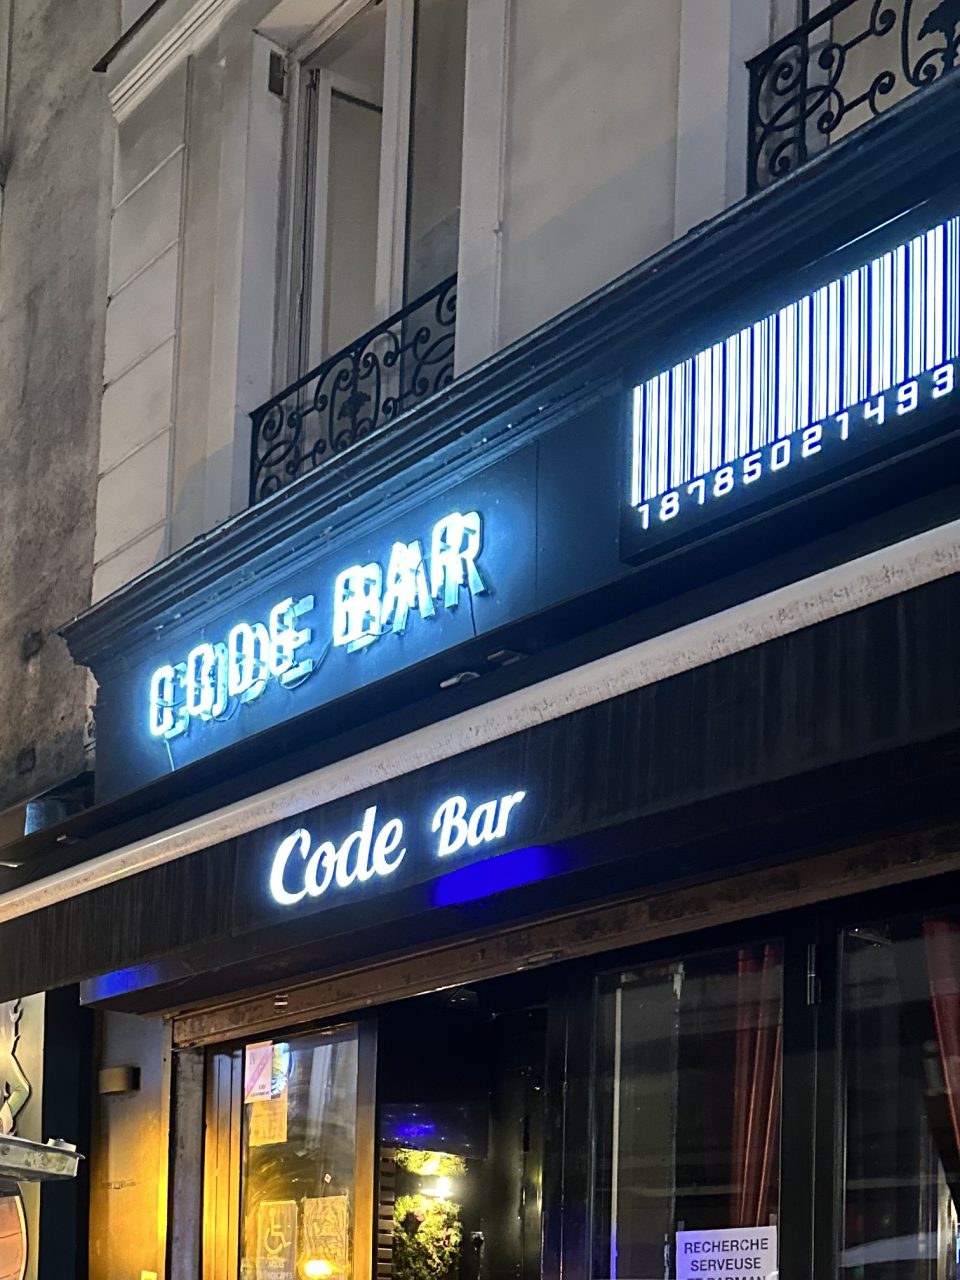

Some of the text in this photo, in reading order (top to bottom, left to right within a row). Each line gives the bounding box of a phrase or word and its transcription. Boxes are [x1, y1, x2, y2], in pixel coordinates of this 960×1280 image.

[149, 510, 486, 740] CODE BAR
[268, 789, 527, 906] Code Bar
[684, 1238, 769, 1254] RECHERCHE
[690, 1257, 762, 1272] SERVEUSE
